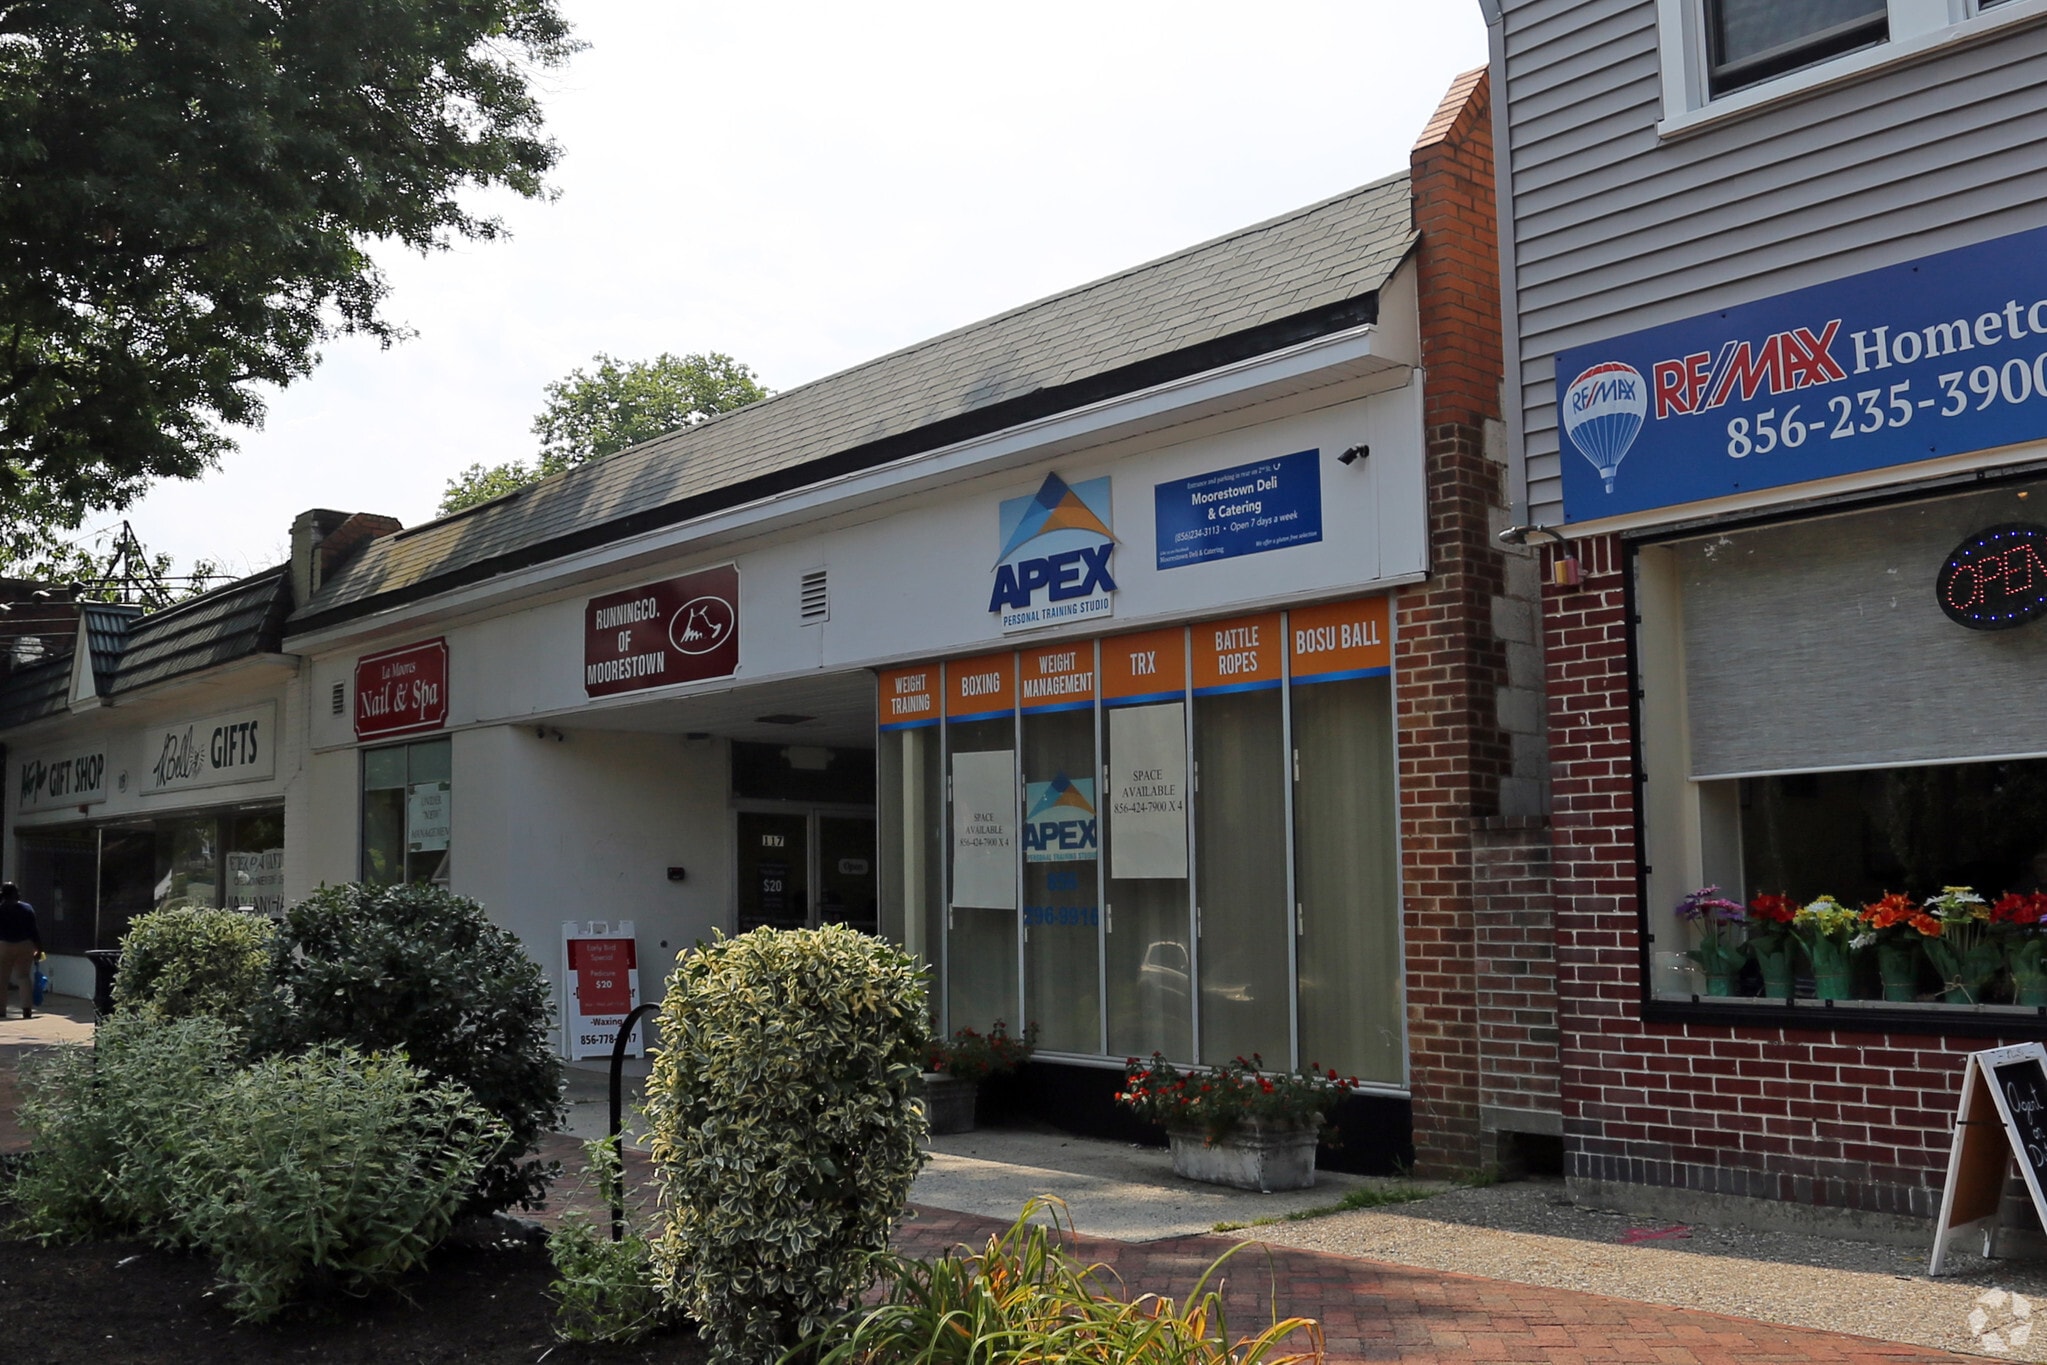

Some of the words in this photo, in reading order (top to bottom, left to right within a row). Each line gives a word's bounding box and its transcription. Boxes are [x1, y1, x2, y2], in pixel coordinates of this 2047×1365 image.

[1653, 318, 1847, 420] RE/MAX
[1572, 378, 1637, 415] RE/MAX
[1191, 484, 1254, 505] Moorestown
[1257, 475, 1278, 491] Deli
[1208, 507, 1216, 520] &
[1218, 501, 1262, 517] Catering
[1230, 522, 1249, 532] Open
[1250, 518, 1256, 527] 7
[1256, 516, 1272, 527] days
[1279, 510, 1298, 522] week
[988, 542, 1118, 613] APEX
[1947, 536, 2047, 610] OPEN
[1003, 610, 1039, 626] PERSONAL
[1042, 603, 1078, 620] TRAINING
[1080, 598, 1109, 613] STUDIO
[618, 630, 632, 652] OF
[1215, 626, 1259, 651] BATTLE
[1296, 626, 1336, 654] BOSU
[1341, 620, 1380, 649] BALL
[587, 651, 664, 685] MOORESTOWN
[1039, 652, 1076, 674] WEIGHT
[1130, 651, 1156, 675] TRX
[1218, 650, 1258, 675] ROPES
[895, 673, 926, 694] WEIGHT
[961, 672, 1000, 697] BOXING
[1023, 672, 1093, 698] MANAGEMENT
[360, 682, 391, 719] Nail
[393, 682, 408, 712] &
[412, 679, 438, 720] Spa
[891, 693, 930, 715] TRAINING
[210, 720, 258, 769] GIFTS
[50, 760, 72, 797] GIFT
[75, 753, 104, 793] SHOP
[1133, 769, 1163, 781] SPACE
[1122, 785, 1176, 798] AVAILABLE
[974, 812, 994, 822] SPACE
[1113, 801, 1167, 814] 856-424-7900
[1168, 800, 1176, 812] X
[1177, 800, 1183, 811] 4
[411, 826, 450, 839] MANAGEMEN
[763, 836, 783, 846] 117
[966, 825, 1003, 835] AVAILABLE
[1023, 819, 1097, 851] APEX
[763, 879, 782, 892] $20
